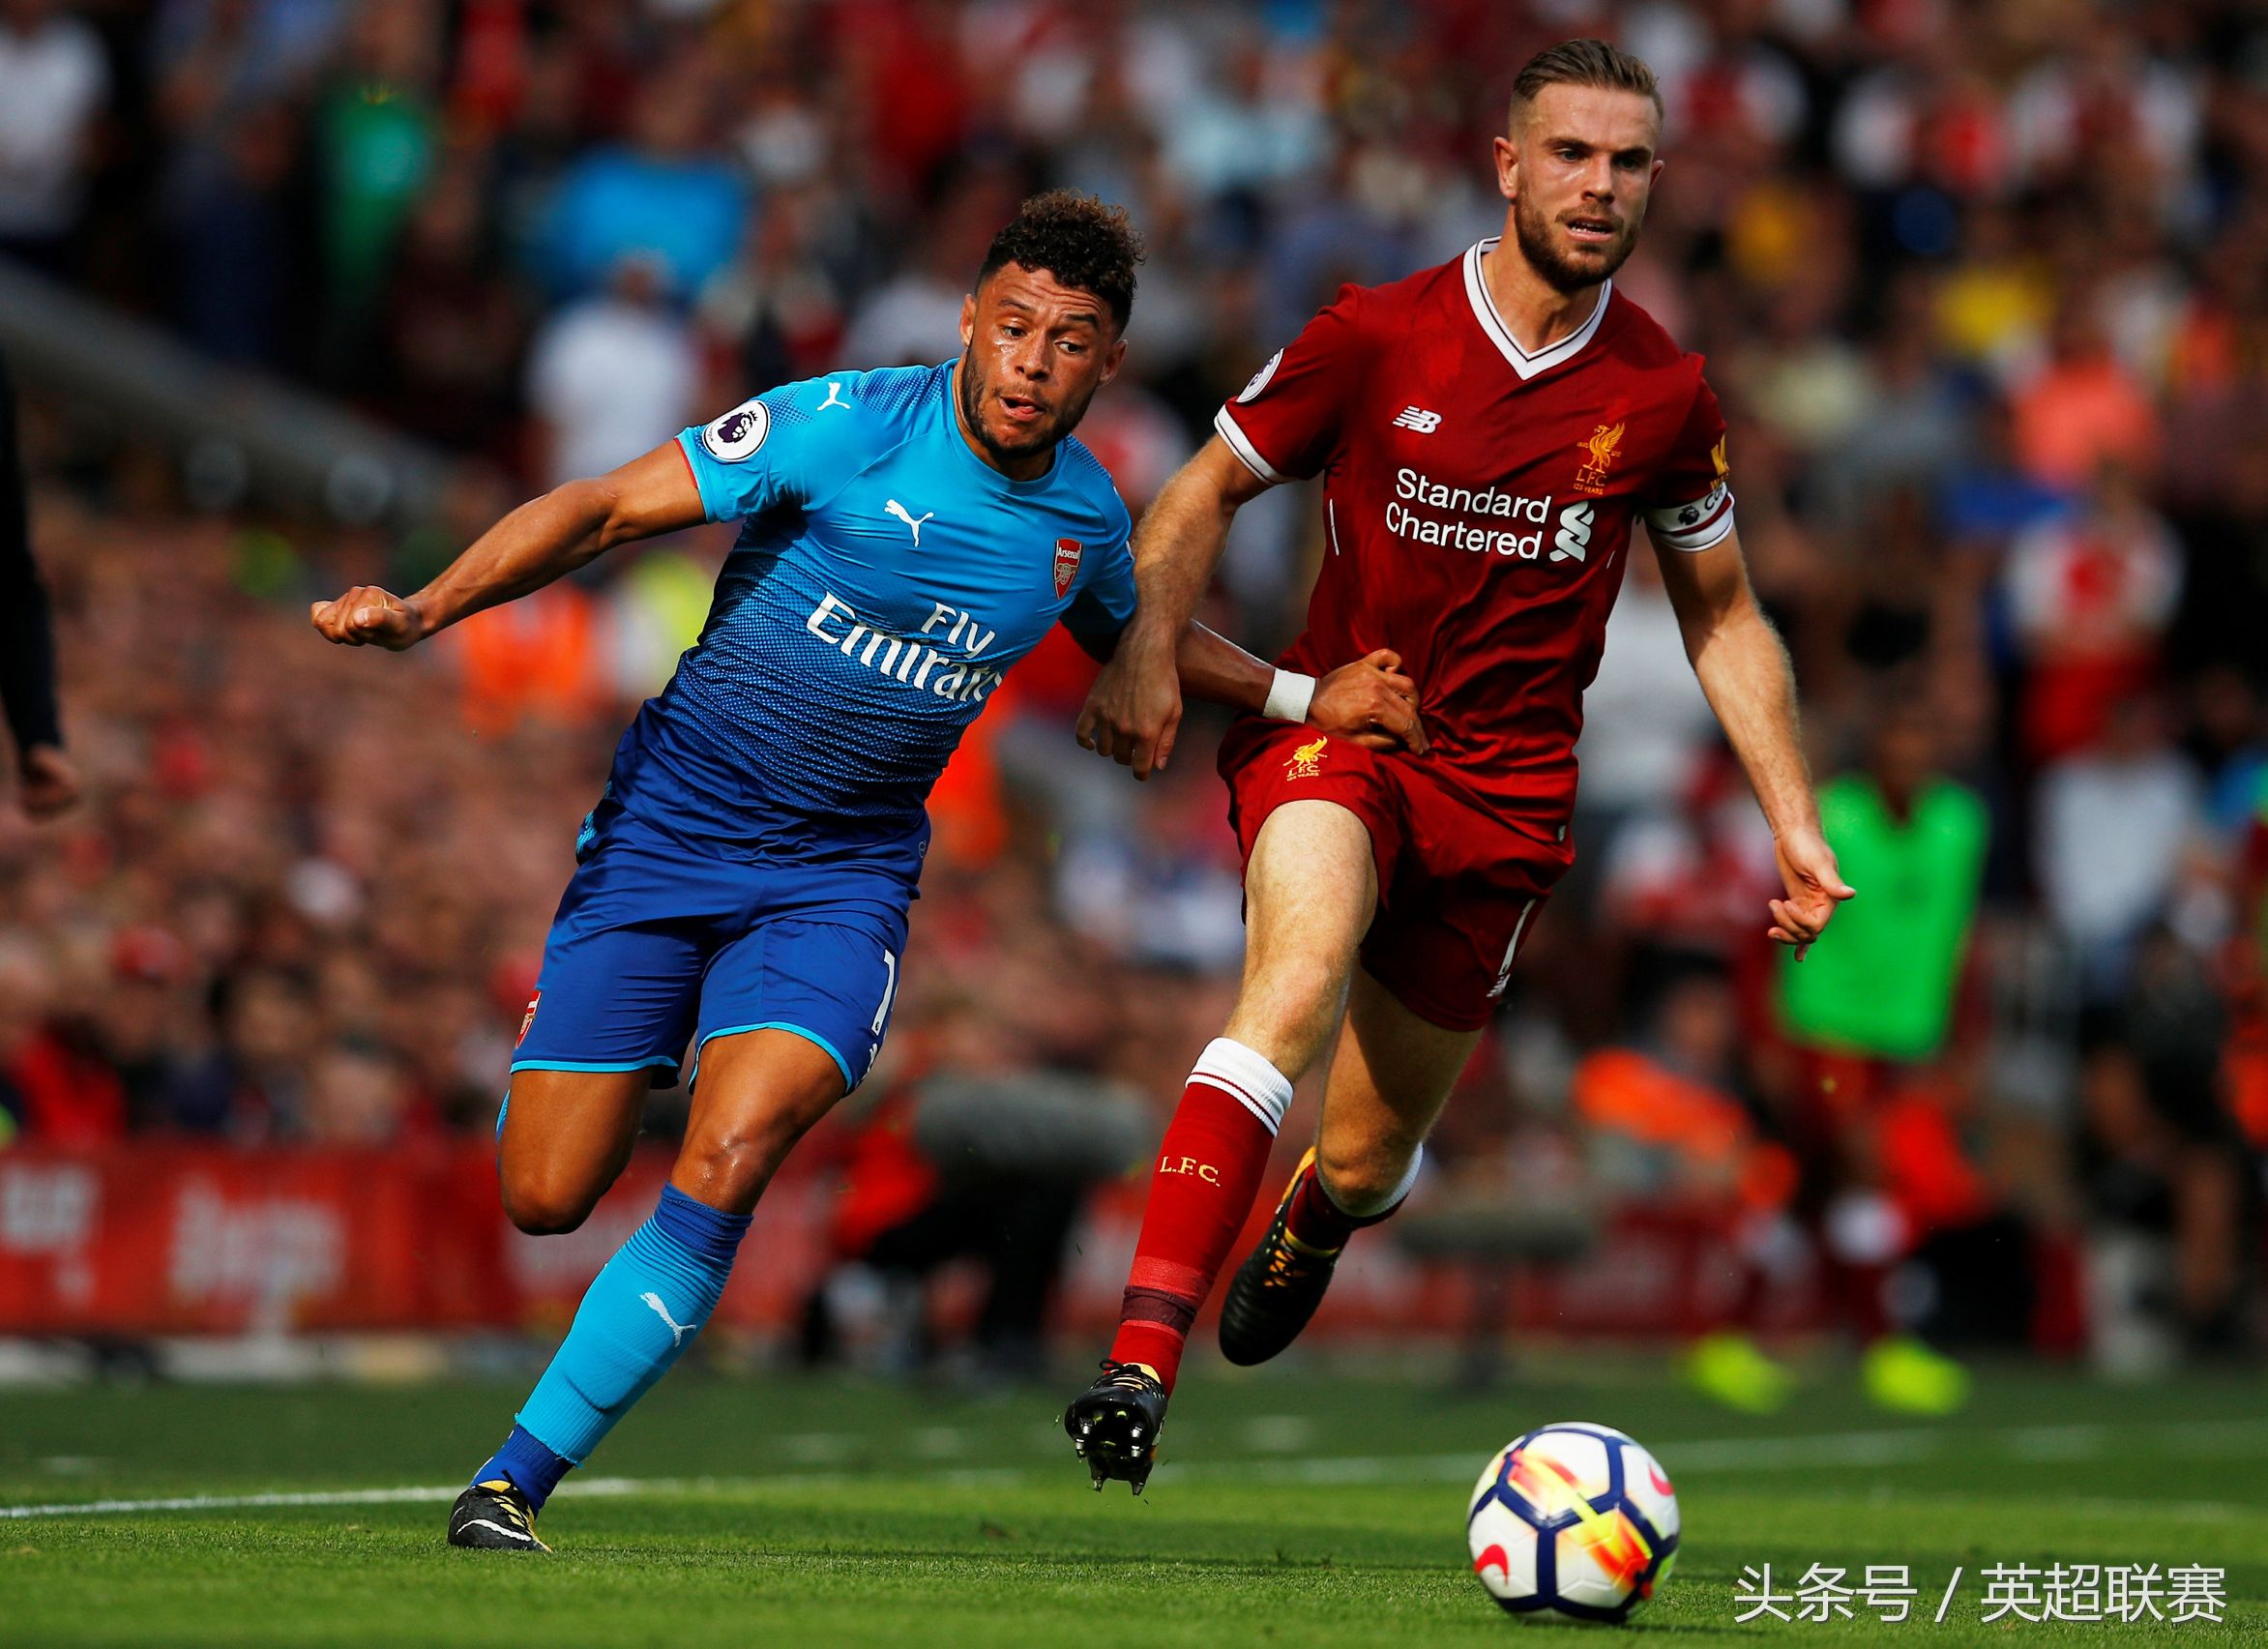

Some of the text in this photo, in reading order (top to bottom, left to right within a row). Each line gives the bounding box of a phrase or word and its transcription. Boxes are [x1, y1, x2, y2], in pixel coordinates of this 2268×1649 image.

[1396, 468, 1551, 524] Standard
[1057, 546, 1080, 560] Arsenal
[1386, 501, 1544, 560] Chartered
[807, 590, 1004, 703] Emirate
[920, 602, 996, 660] Fly
